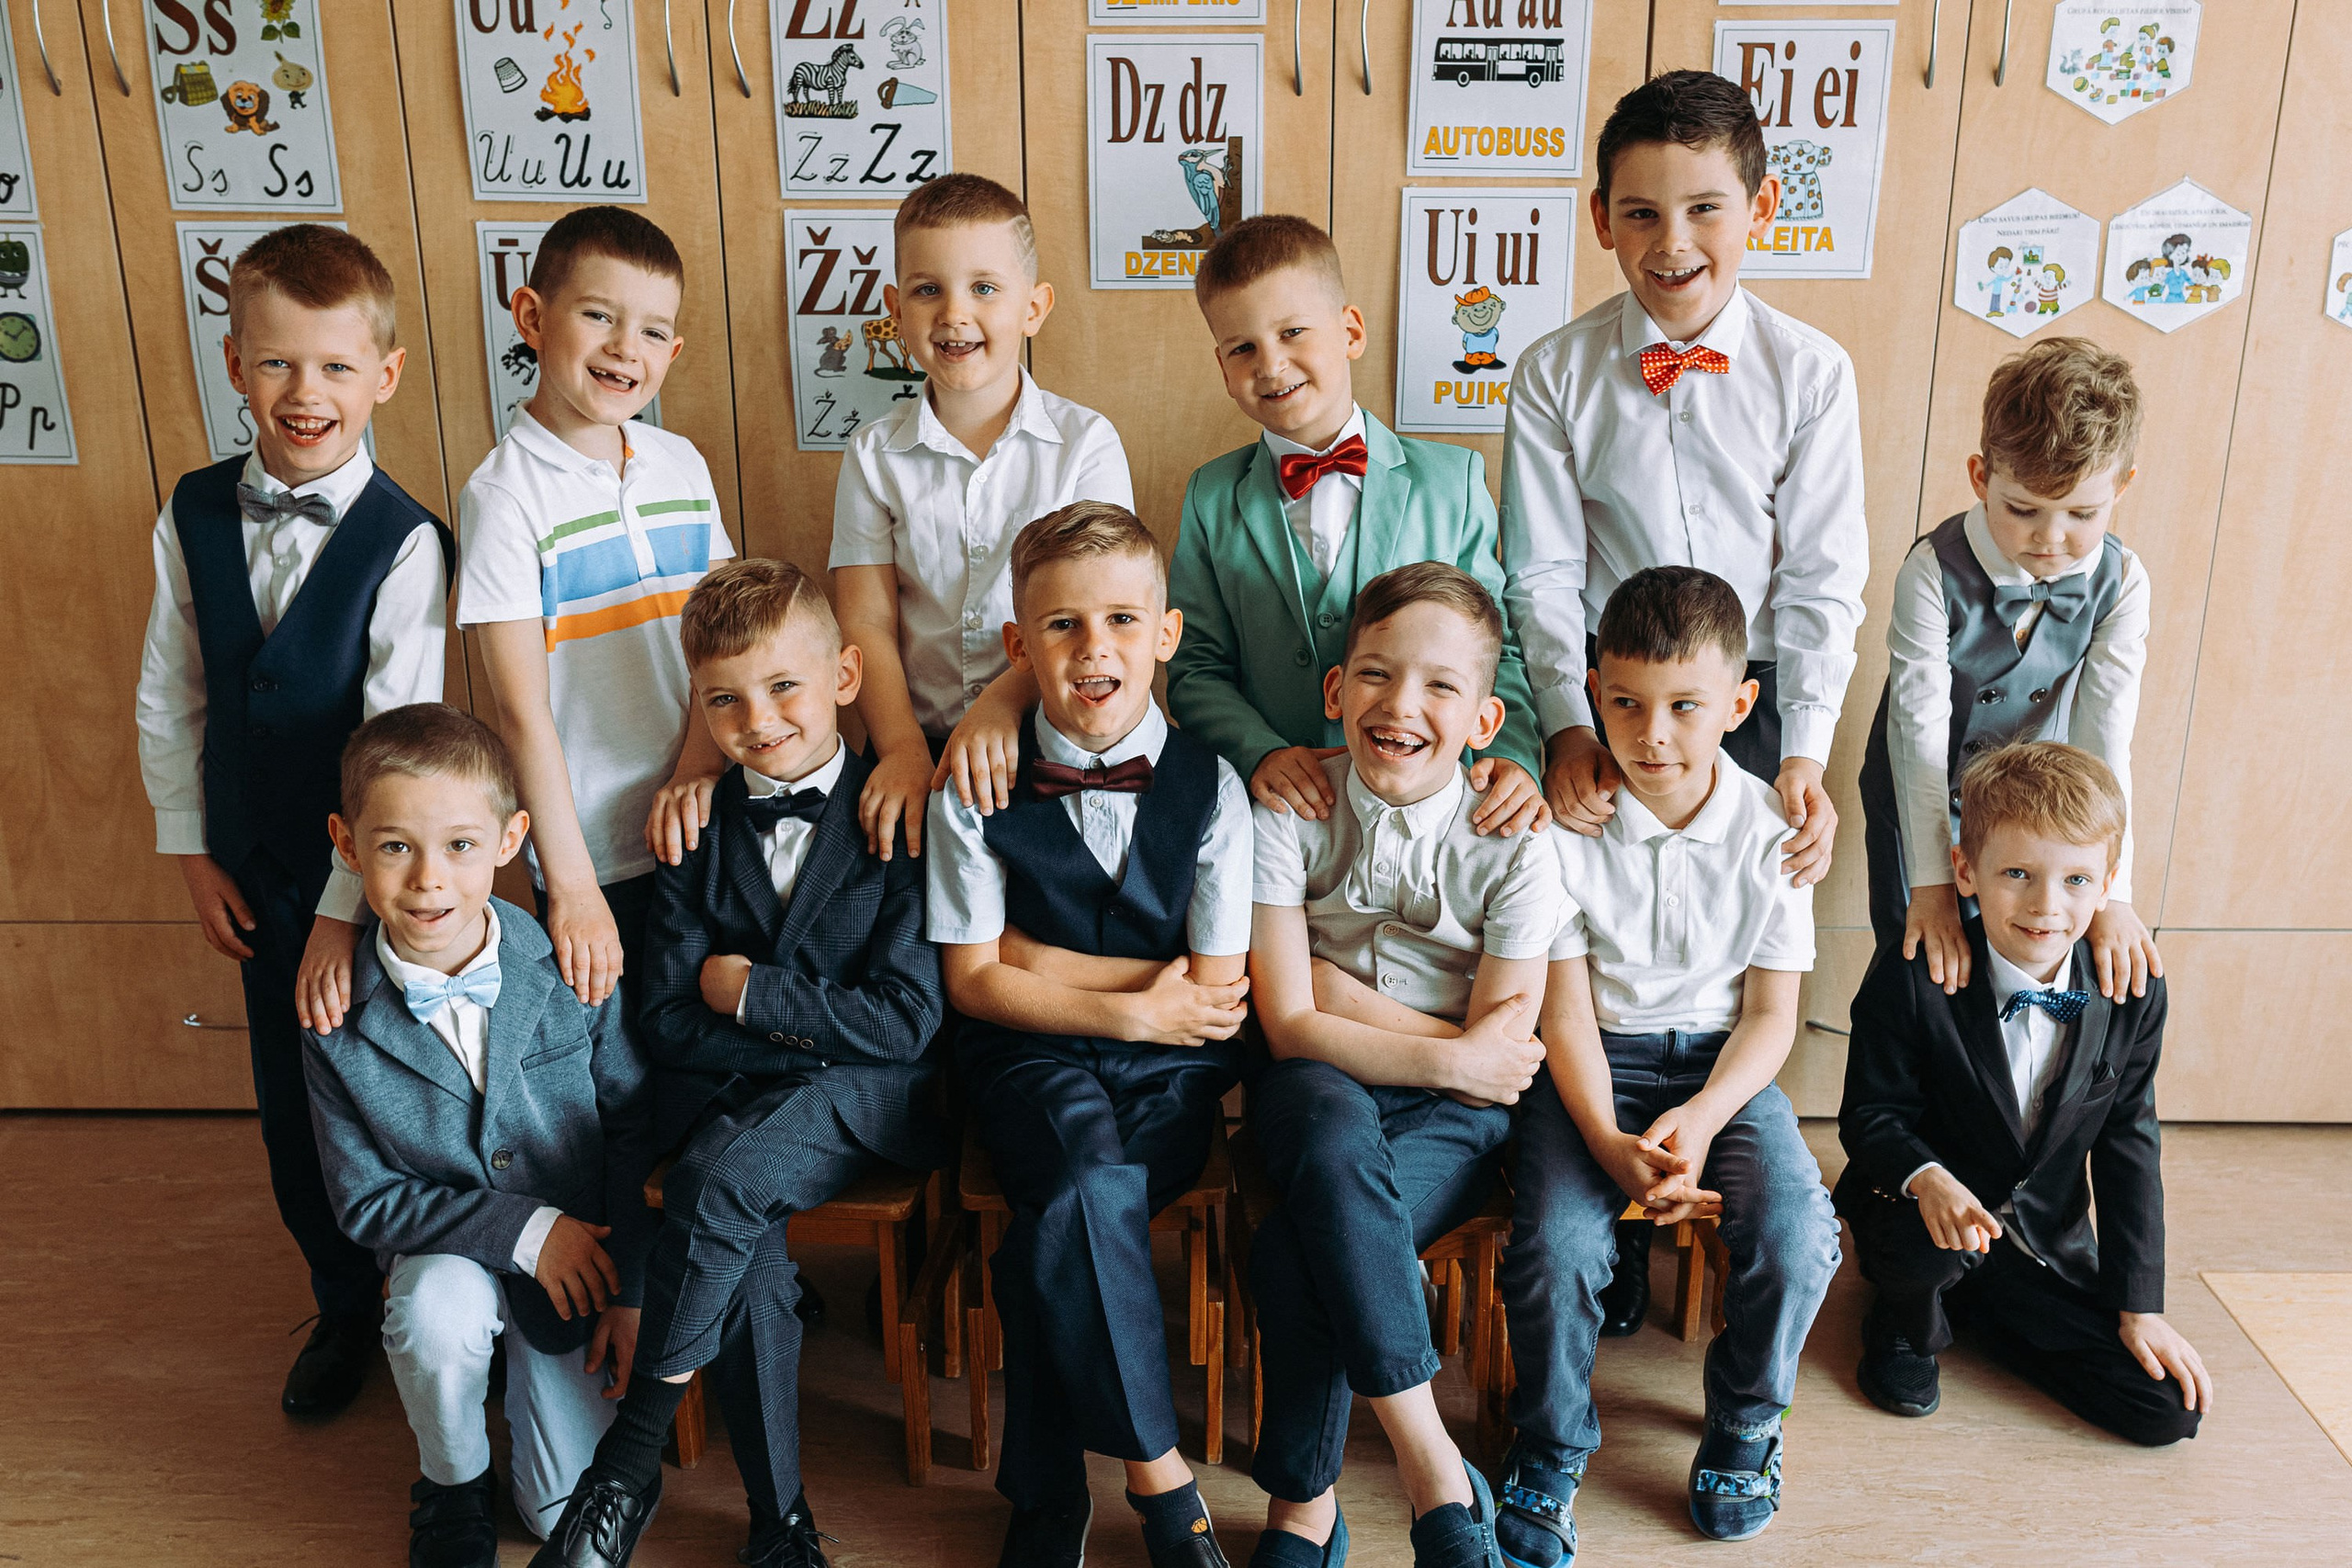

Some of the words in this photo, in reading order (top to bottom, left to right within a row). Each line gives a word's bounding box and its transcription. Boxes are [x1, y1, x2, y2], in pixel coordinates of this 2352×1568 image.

[1106, 57, 1165, 143] Dz
[1179, 57, 1227, 144] dz
[1737, 40, 1796, 128] Ei
[1814, 40, 1861, 129] ei
[1424, 126, 1566, 157] AUTOBUSS
[797, 225, 882, 315] Žž
[1125, 252, 1205, 276] DZEN
[1424, 208, 1478, 287] Ui
[1496, 208, 1540, 287] ui
